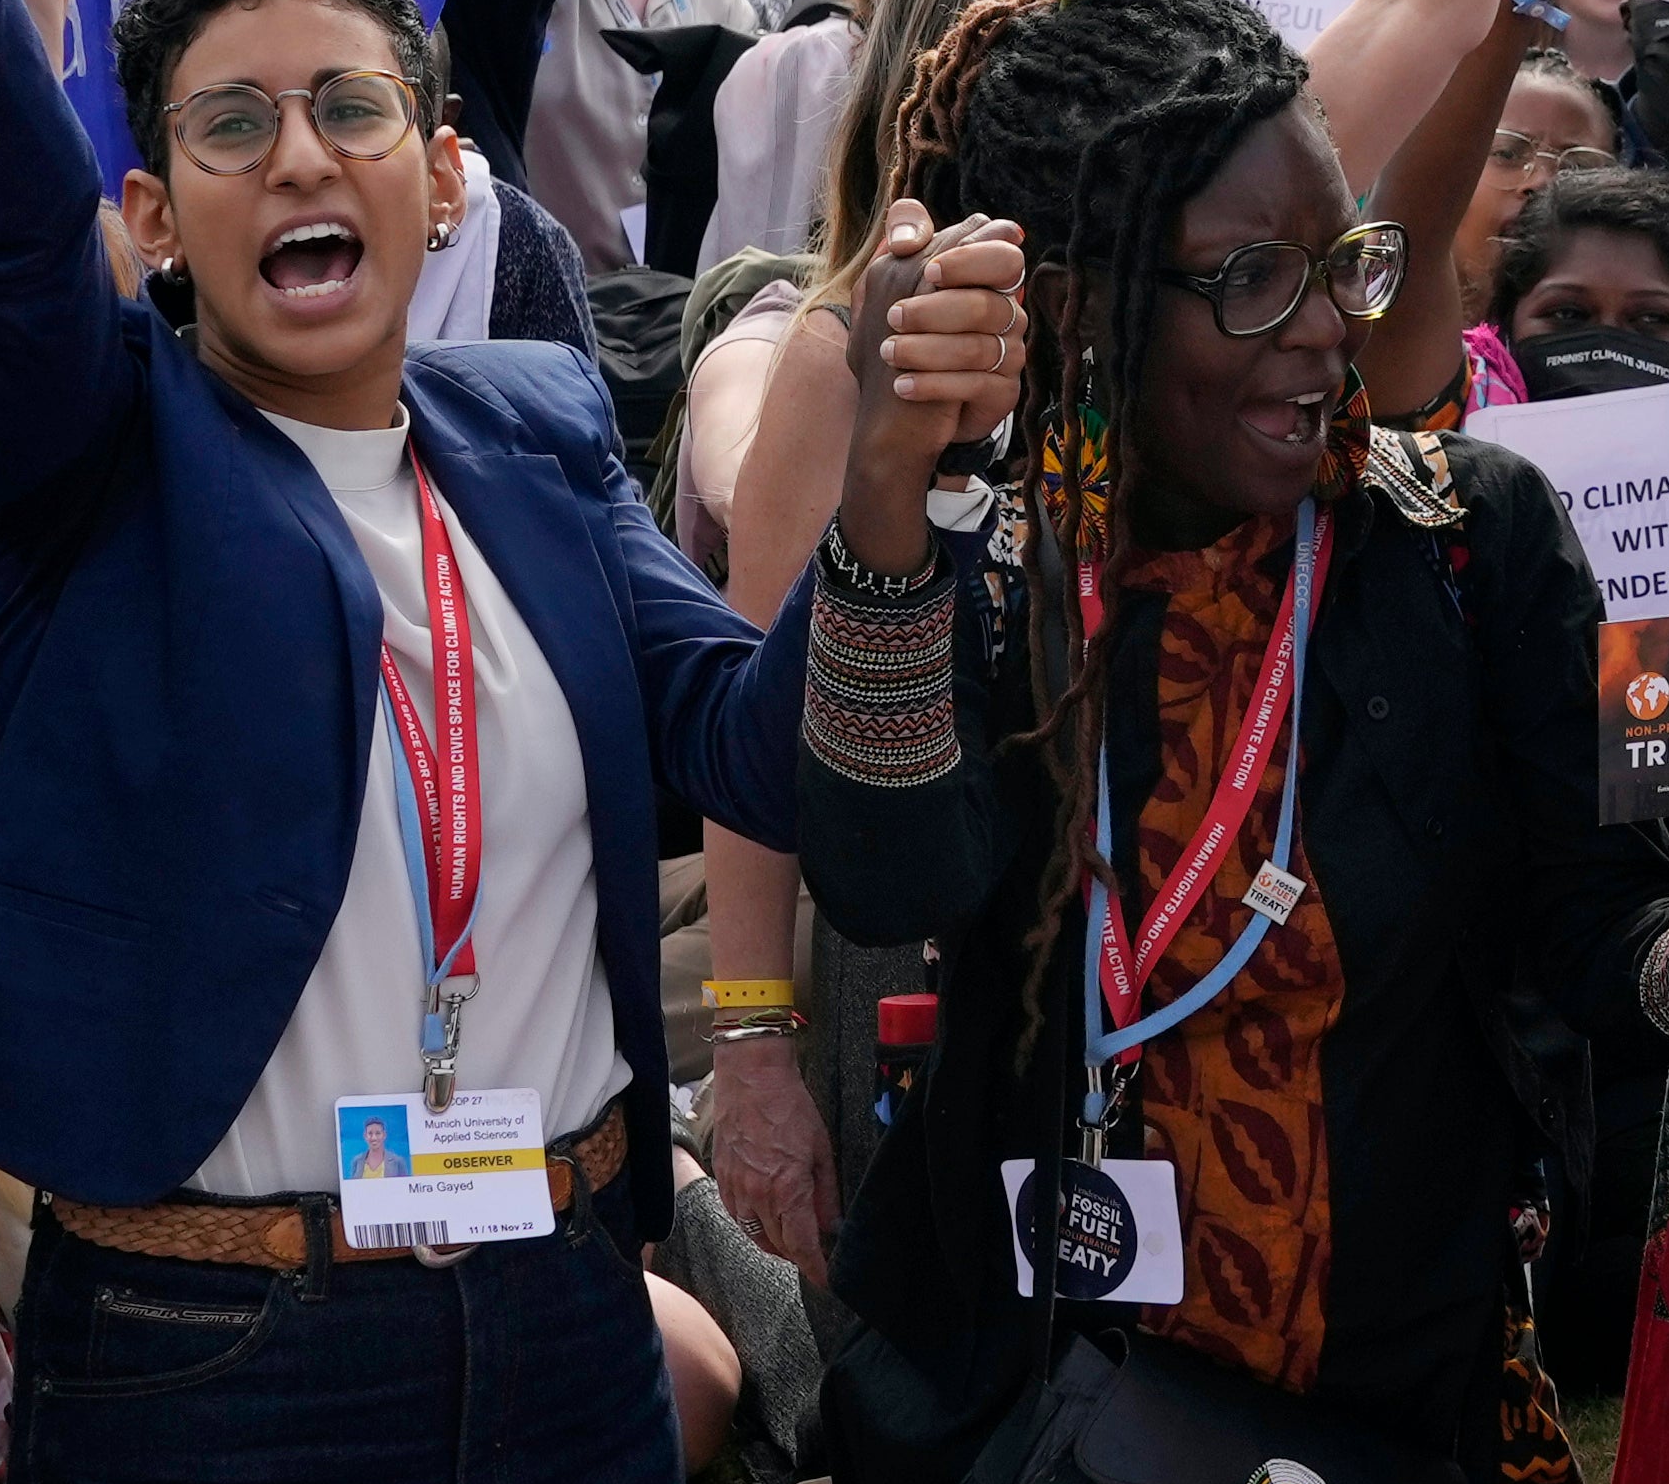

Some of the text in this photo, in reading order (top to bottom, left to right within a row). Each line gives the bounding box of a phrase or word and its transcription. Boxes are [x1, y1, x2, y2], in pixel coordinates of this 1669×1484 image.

[1545, 351, 1590, 368] FEMINIST
[1591, 349, 1634, 368] CLIMATE
[386, 665, 406, 703] CIVIC
[401, 703, 423, 749] SPACE
[414, 749, 430, 779] FOR
[436, 553, 467, 901] HUMAN RIGHTS AND CIVIC SPACE FOR CLIMATE ACTION
[1231, 659, 1287, 791] FOR CLIMATE ACTION
[1196, 822, 1227, 869] HUMAN
[1164, 868, 1198, 915] RIGHTS
[1249, 888, 1289, 916] TREATY
[1144, 914, 1170, 940] AND
[1109, 946, 1131, 996] ACTION
[471, 1096, 482, 1106] 27
[425, 1115, 525, 1130] Munich University of
[433, 1129, 519, 1144] Applied Sciences
[443, 1155, 514, 1170] OBSERVER
[408, 1180, 474, 1195] Mira Gayed
[1072, 1193, 1124, 1226] FOSSIL
[469, 1225, 479, 1235] 11
[488, 1224, 498, 1234] 18
[501, 1223, 520, 1233] Nov
[522, 1221, 534, 1231] 22
[1069, 1210, 1121, 1245] FUEL
[1058, 1239, 1118, 1278] EATY
